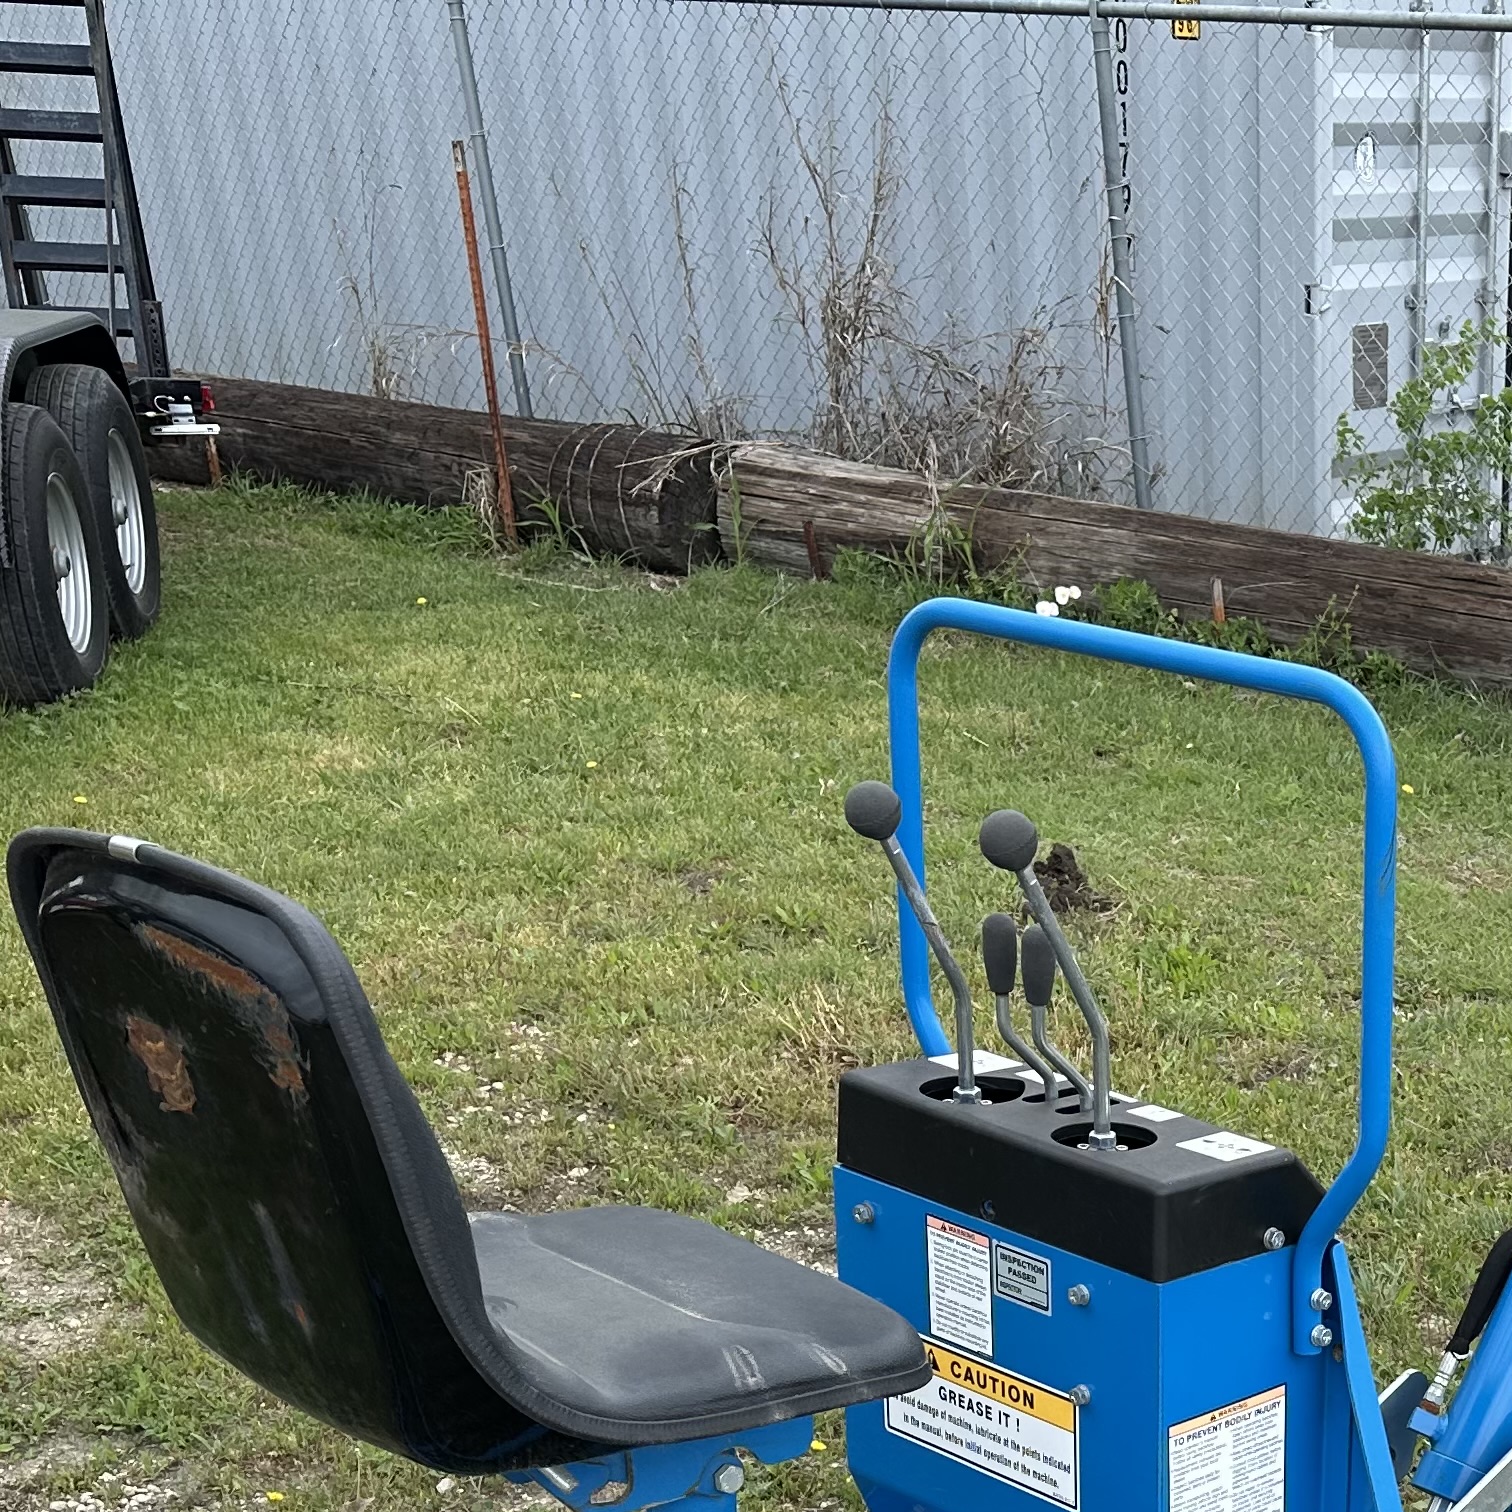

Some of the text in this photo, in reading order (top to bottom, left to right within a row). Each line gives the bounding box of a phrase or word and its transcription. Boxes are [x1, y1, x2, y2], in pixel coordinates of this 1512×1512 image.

[999, 1252, 1045, 1276] INSPECTION
[1007, 1267, 1037, 1284] PASSED
[938, 1386, 993, 1421] GREASE
[998, 1410, 1011, 1428] IT
[950, 1361, 1035, 1410] CAUTION
[910, 1415, 920, 1428] the
[944, 1429, 963, 1447] before
[983, 1448, 1012, 1468] operation
[1021, 1463, 1031, 1476] the
[917, 1400, 939, 1418] damage
[1010, 1439, 1020, 1452] the
[1173, 1400, 1281, 1447] TO PREVENT BODILY INJURY
